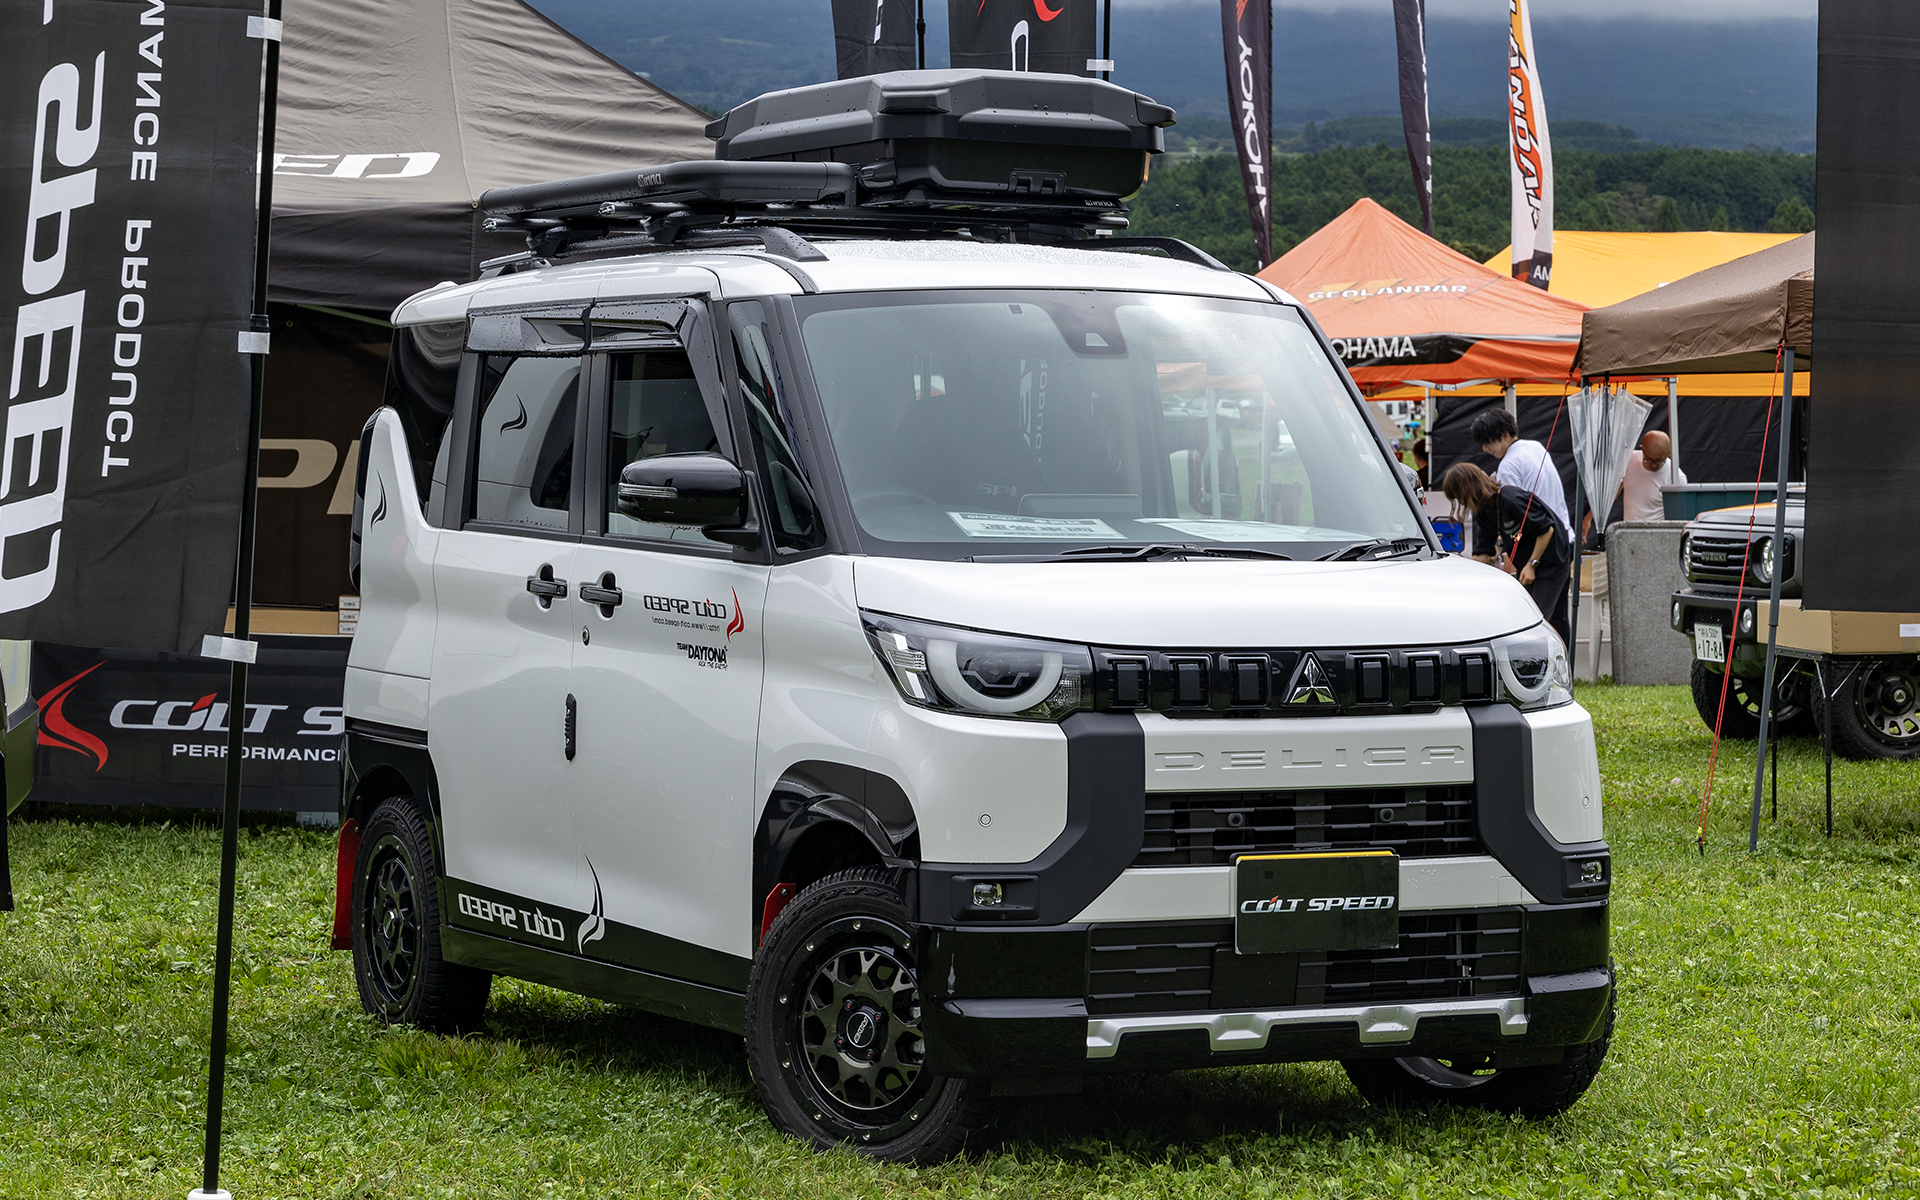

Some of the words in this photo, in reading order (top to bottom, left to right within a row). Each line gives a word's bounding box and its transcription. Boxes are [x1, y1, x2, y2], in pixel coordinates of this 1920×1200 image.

[1308, 284, 1468, 300] GEOLANDAR
[1701, 551, 1727, 561] SUZUKI
[676, 642, 688, 651] TEAM
[688, 644, 727, 664] DAYTONA
[109, 692, 289, 733] COLT
[1154, 745, 1465, 771] DELICA
[1240, 895, 1304, 914] COLT
[1307, 895, 1395, 912] SPEED
